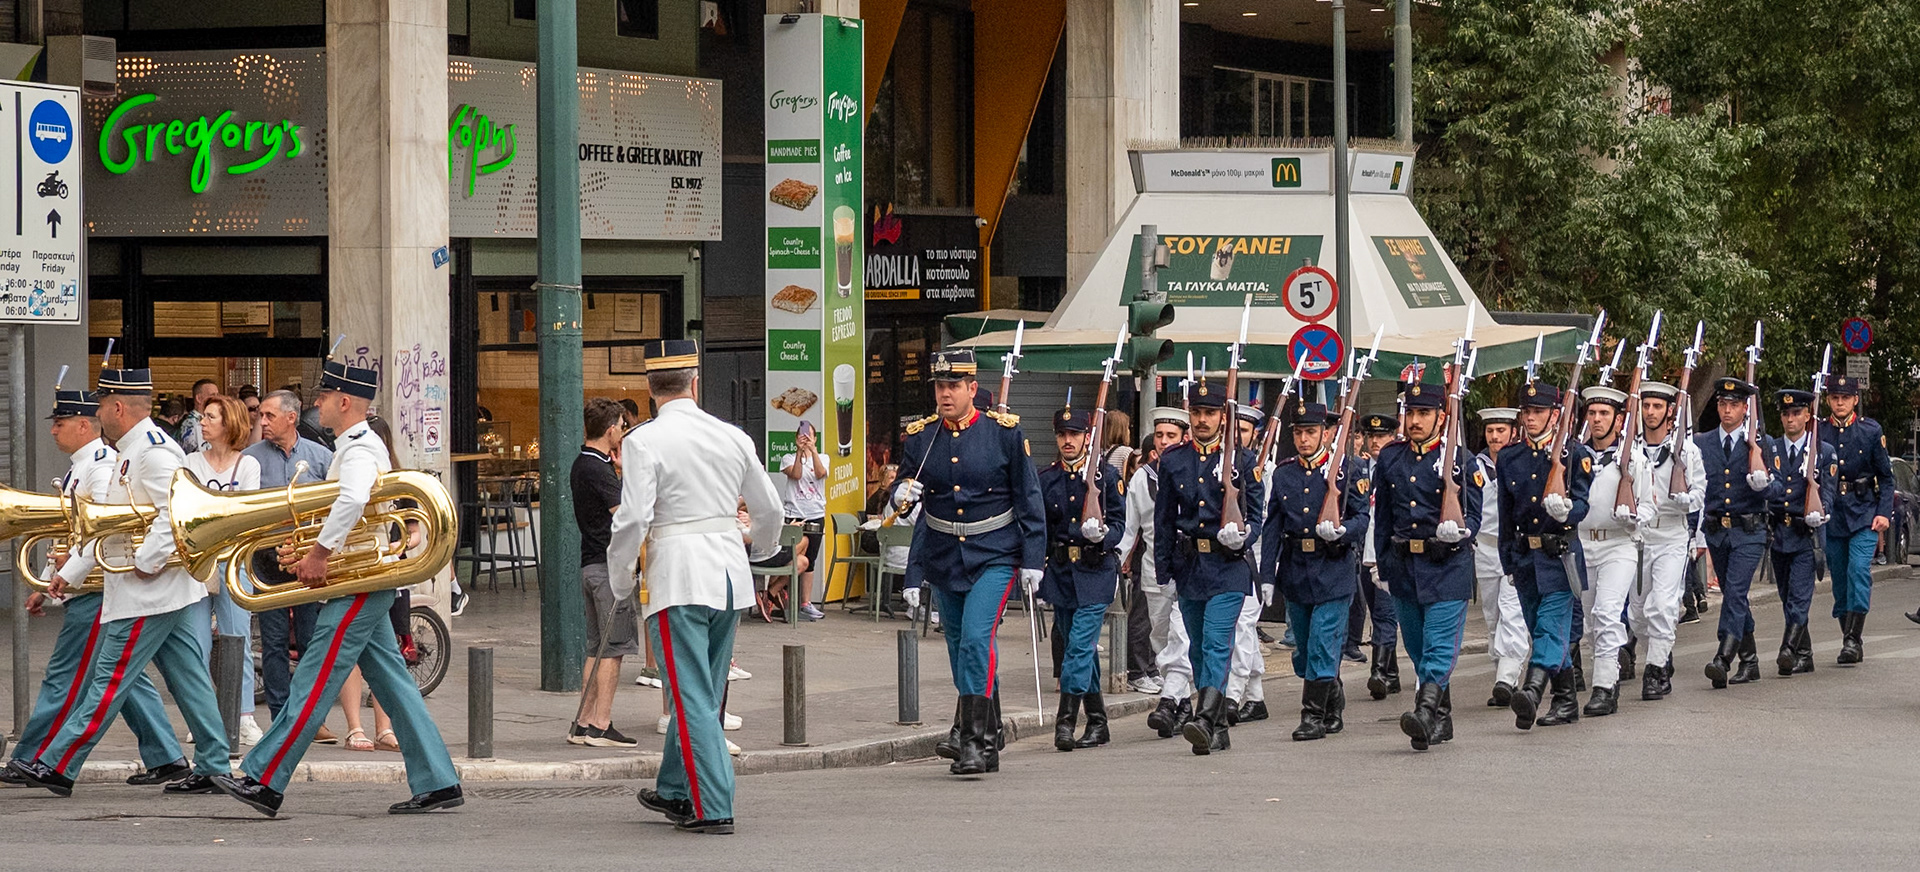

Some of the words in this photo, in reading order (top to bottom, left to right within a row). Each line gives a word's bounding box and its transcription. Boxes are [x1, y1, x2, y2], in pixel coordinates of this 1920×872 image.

[769, 89, 818, 113] Gregory's
[99, 93, 301, 194] Gregory's
[770, 146, 802, 157] HANDMADE
[804, 146, 817, 157] PIES
[579, 143, 614, 162] OFFEE
[616, 145, 625, 162] &
[626, 146, 661, 165] GREEK
[663, 148, 703, 167] BAKERY
[833, 143, 851, 162] Coffee
[835, 172, 843, 185] on
[843, 166, 852, 183] Ice
[1211, 170, 1226, 178] μόνο
[1244, 169, 1265, 178] μακριά
[783, 237, 803, 247] Country
[1164, 236, 1212, 255] ΣΟΥ
[1216, 236, 1292, 255] ΚΑΝΕΙ
[33, 250, 75, 263] Παρασκευή
[769, 247, 810, 257] Spinach-Cheese
[811, 247, 820, 255] Pie
[926, 249, 935, 260] το
[936, 249, 948, 260] πιο
[949, 246, 977, 262] νόστιμο
[42, 263, 65, 275] Friday
[865, 253, 920, 288] ABDALLA
[926, 264, 970, 280] κοτόπουλο
[34, 280, 55, 290] 21:00
[926, 288, 940, 299] στα
[941, 284, 975, 302] κάρβουνα
[1167, 282, 1183, 291] ΤΑ
[1185, 282, 1223, 291] ΓΛΥΚΑ
[1226, 281, 1270, 293] ΜΑΤΙΑ;
[6, 306, 27, 316] 06:00
[833, 305, 852, 325] FREDDO
[831, 321, 856, 343] ESPRESSO
[783, 340, 806, 352] Country
[780, 351, 798, 361] Cheese
[800, 351, 809, 361] Pie
[771, 442, 789, 451] Greek
[834, 462, 853, 483] FREDDO
[829, 476, 860, 500] CAPPUCCINO
